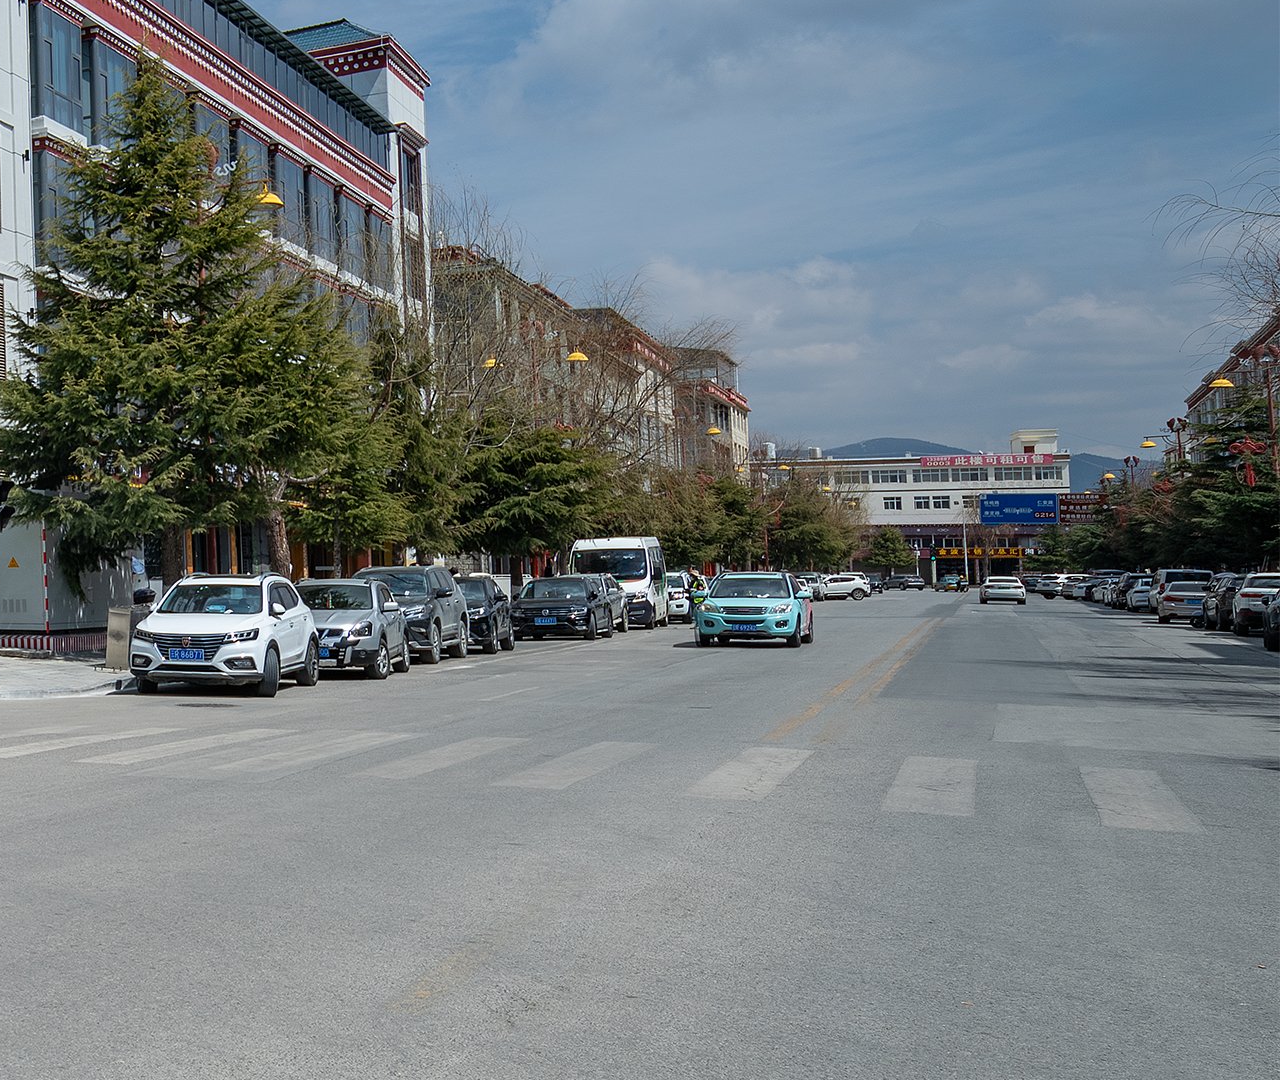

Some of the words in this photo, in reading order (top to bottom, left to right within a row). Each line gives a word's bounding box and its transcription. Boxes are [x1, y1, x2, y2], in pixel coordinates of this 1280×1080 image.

[955, 454, 1044, 466] 此楼可租可售
